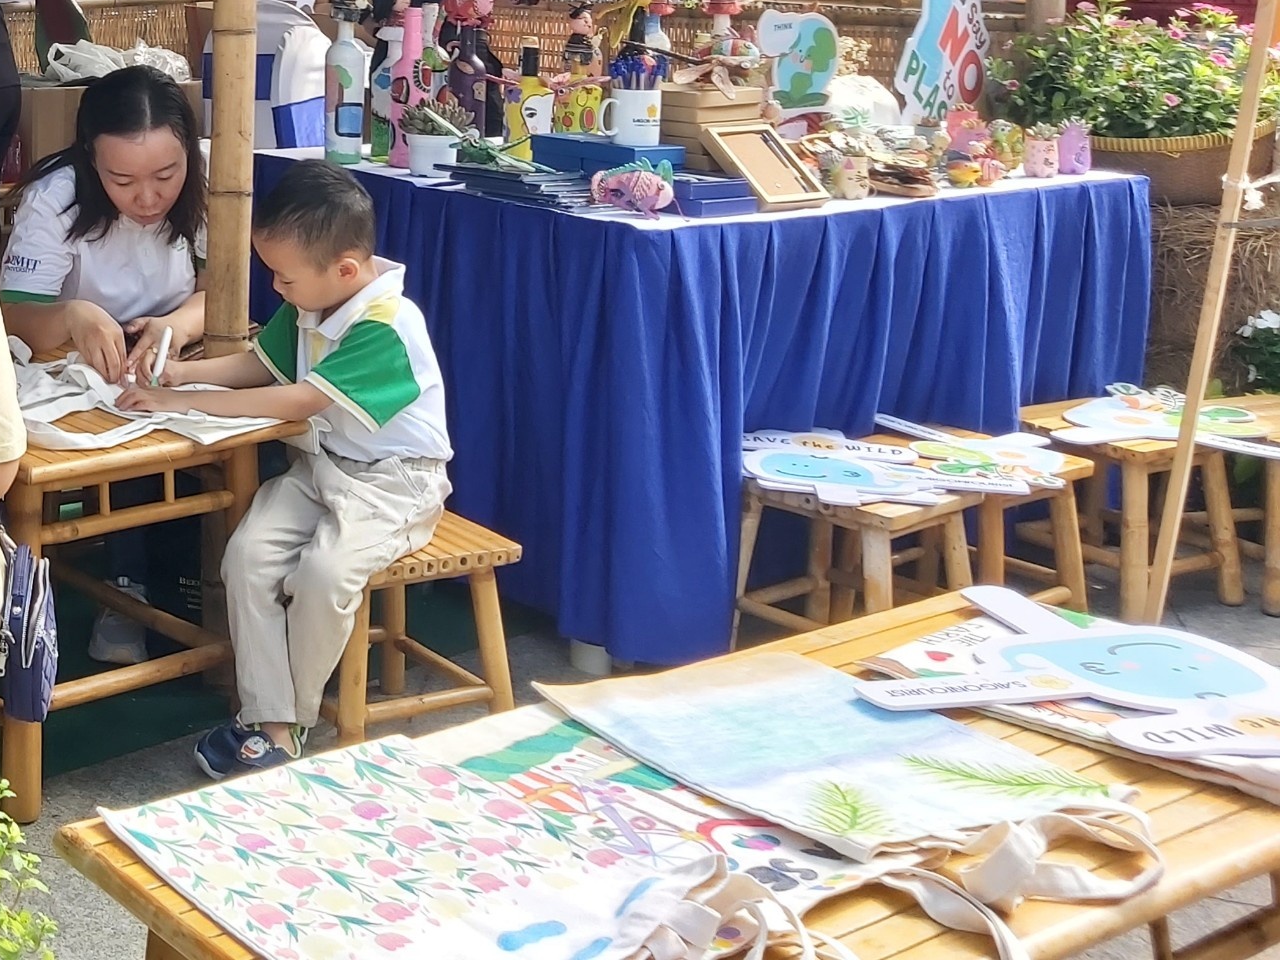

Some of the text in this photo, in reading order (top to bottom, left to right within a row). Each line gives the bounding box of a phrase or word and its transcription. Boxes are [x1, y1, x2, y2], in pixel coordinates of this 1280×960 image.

[938, 5, 984, 105] NO
[845, 444, 902, 456] WILD
[885, 681, 1027, 697] SAIGONTOURIST
[1142, 724, 1245, 744] WILD
